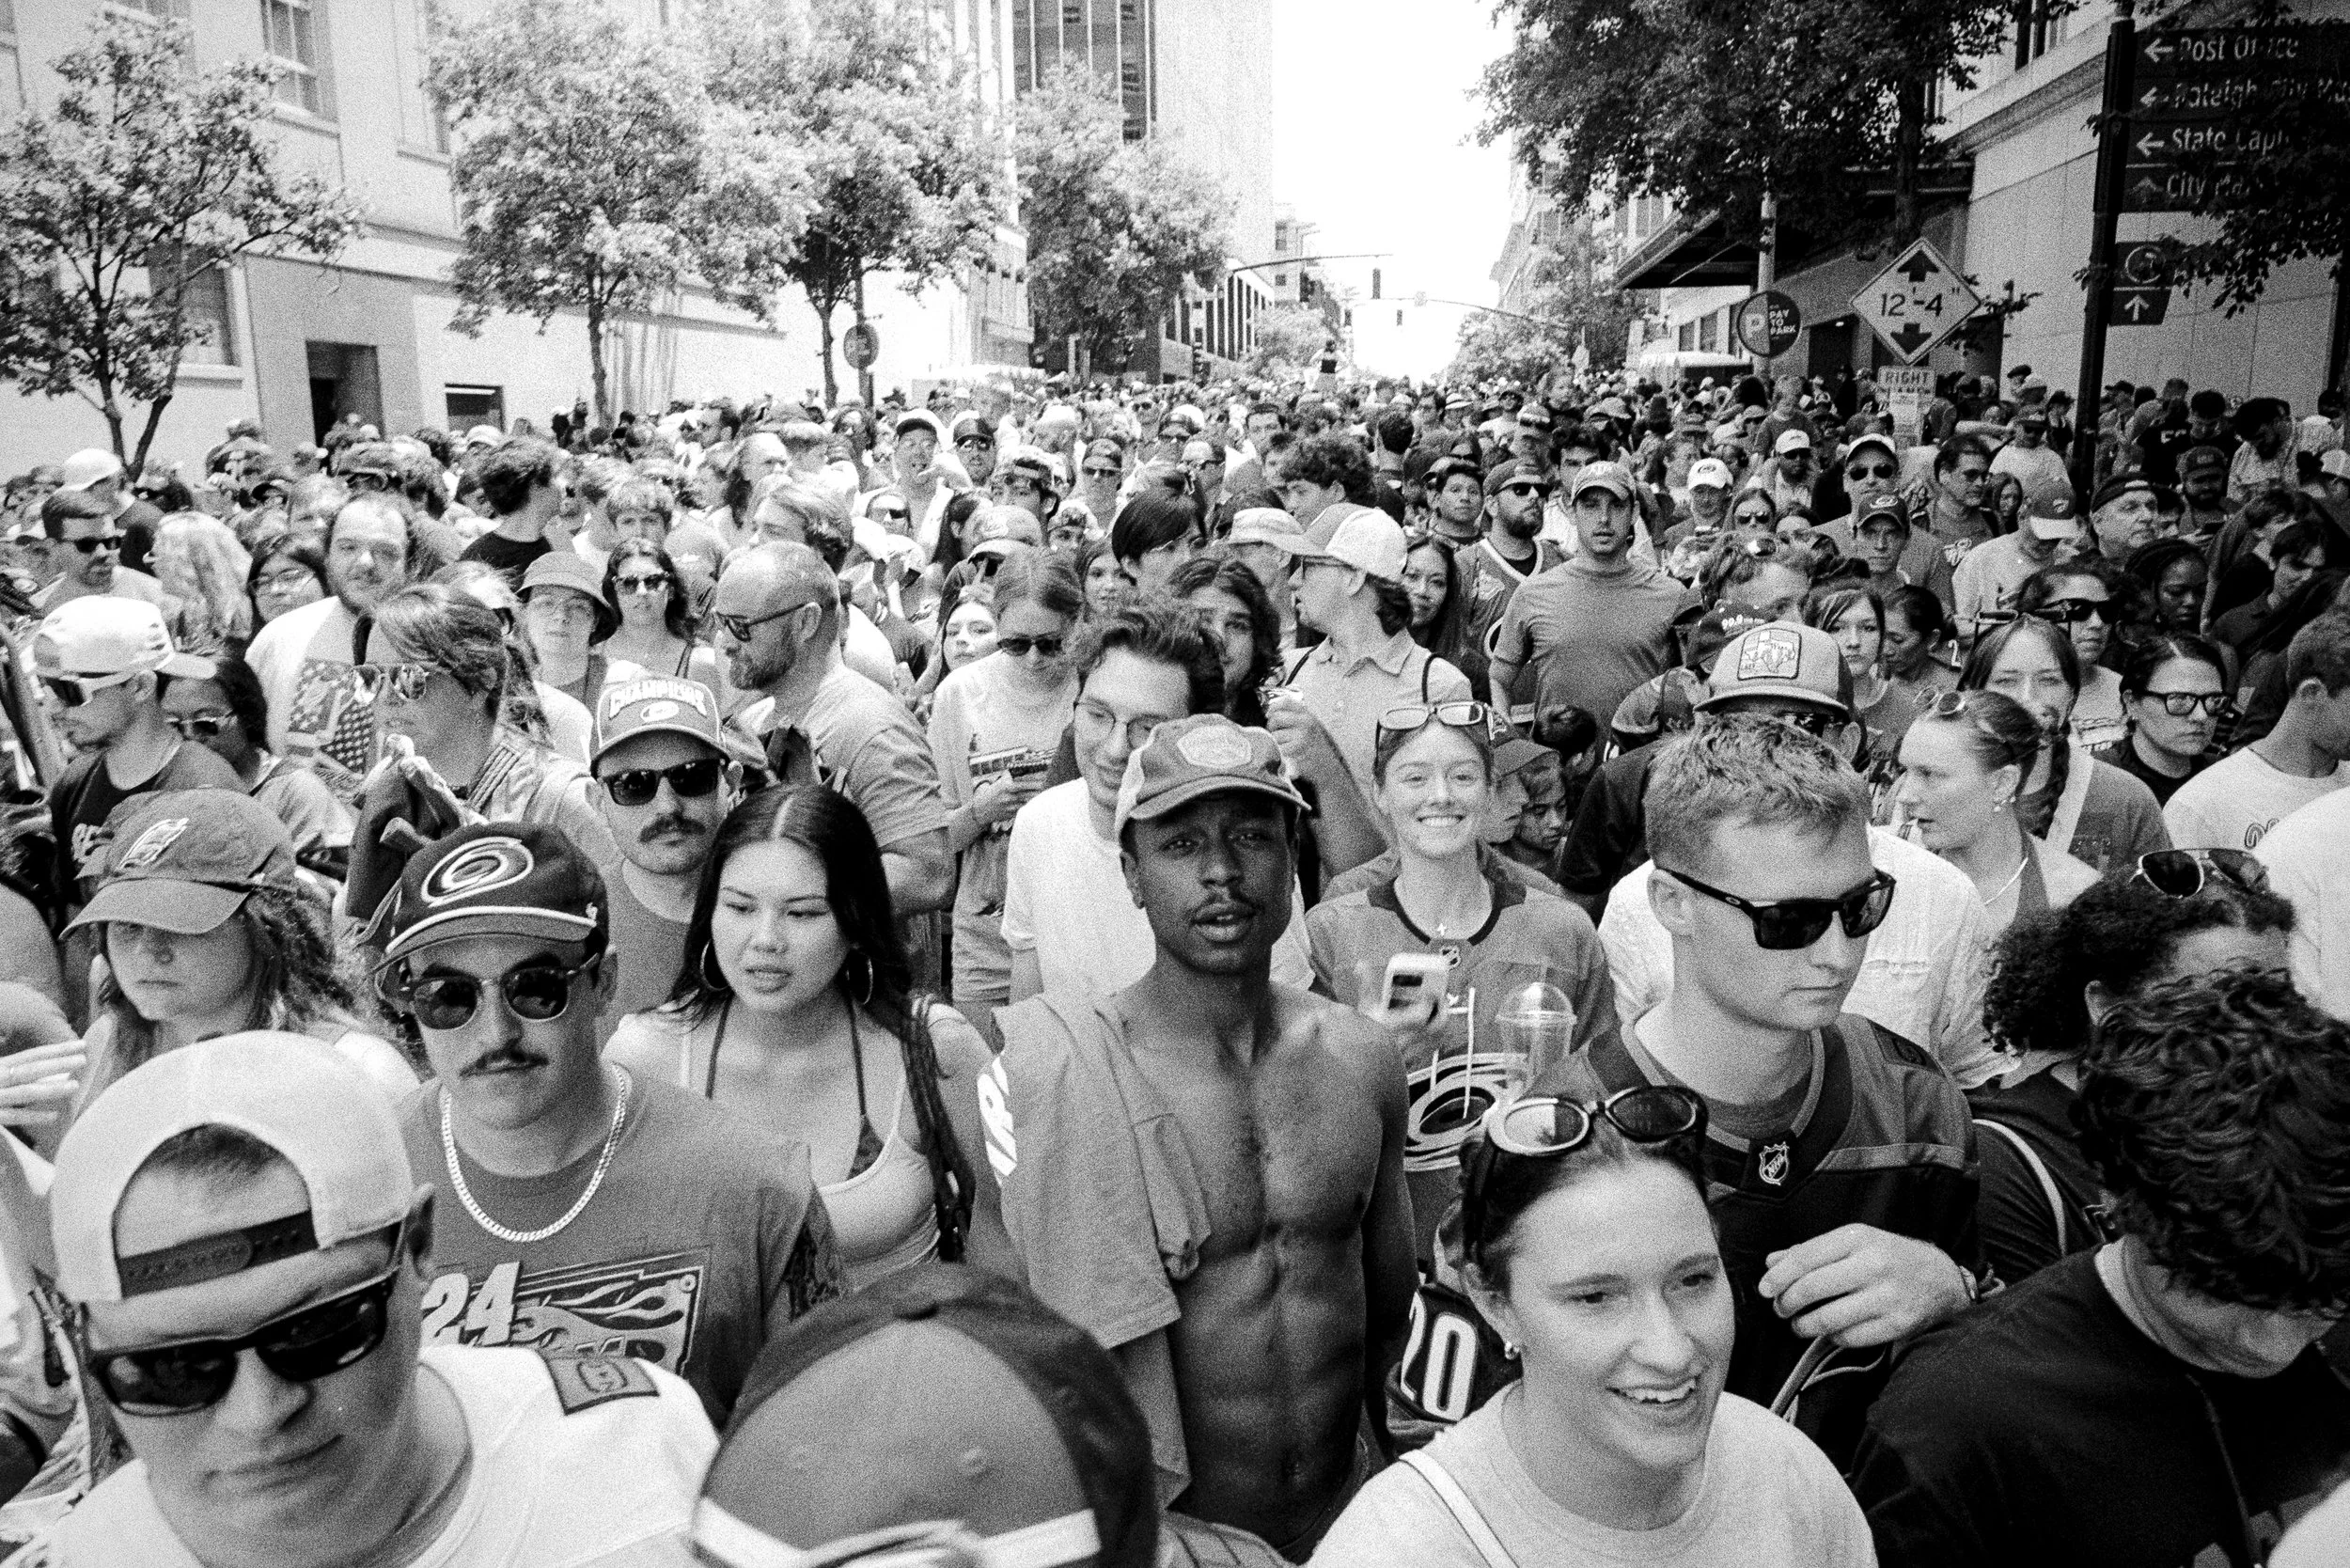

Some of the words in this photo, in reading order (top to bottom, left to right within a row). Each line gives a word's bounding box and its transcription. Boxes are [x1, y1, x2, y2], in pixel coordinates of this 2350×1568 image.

[2172, 127, 2227, 151] State
[1884, 370, 1929, 385] RIGHT
[420, 1261, 520, 1348] 24
